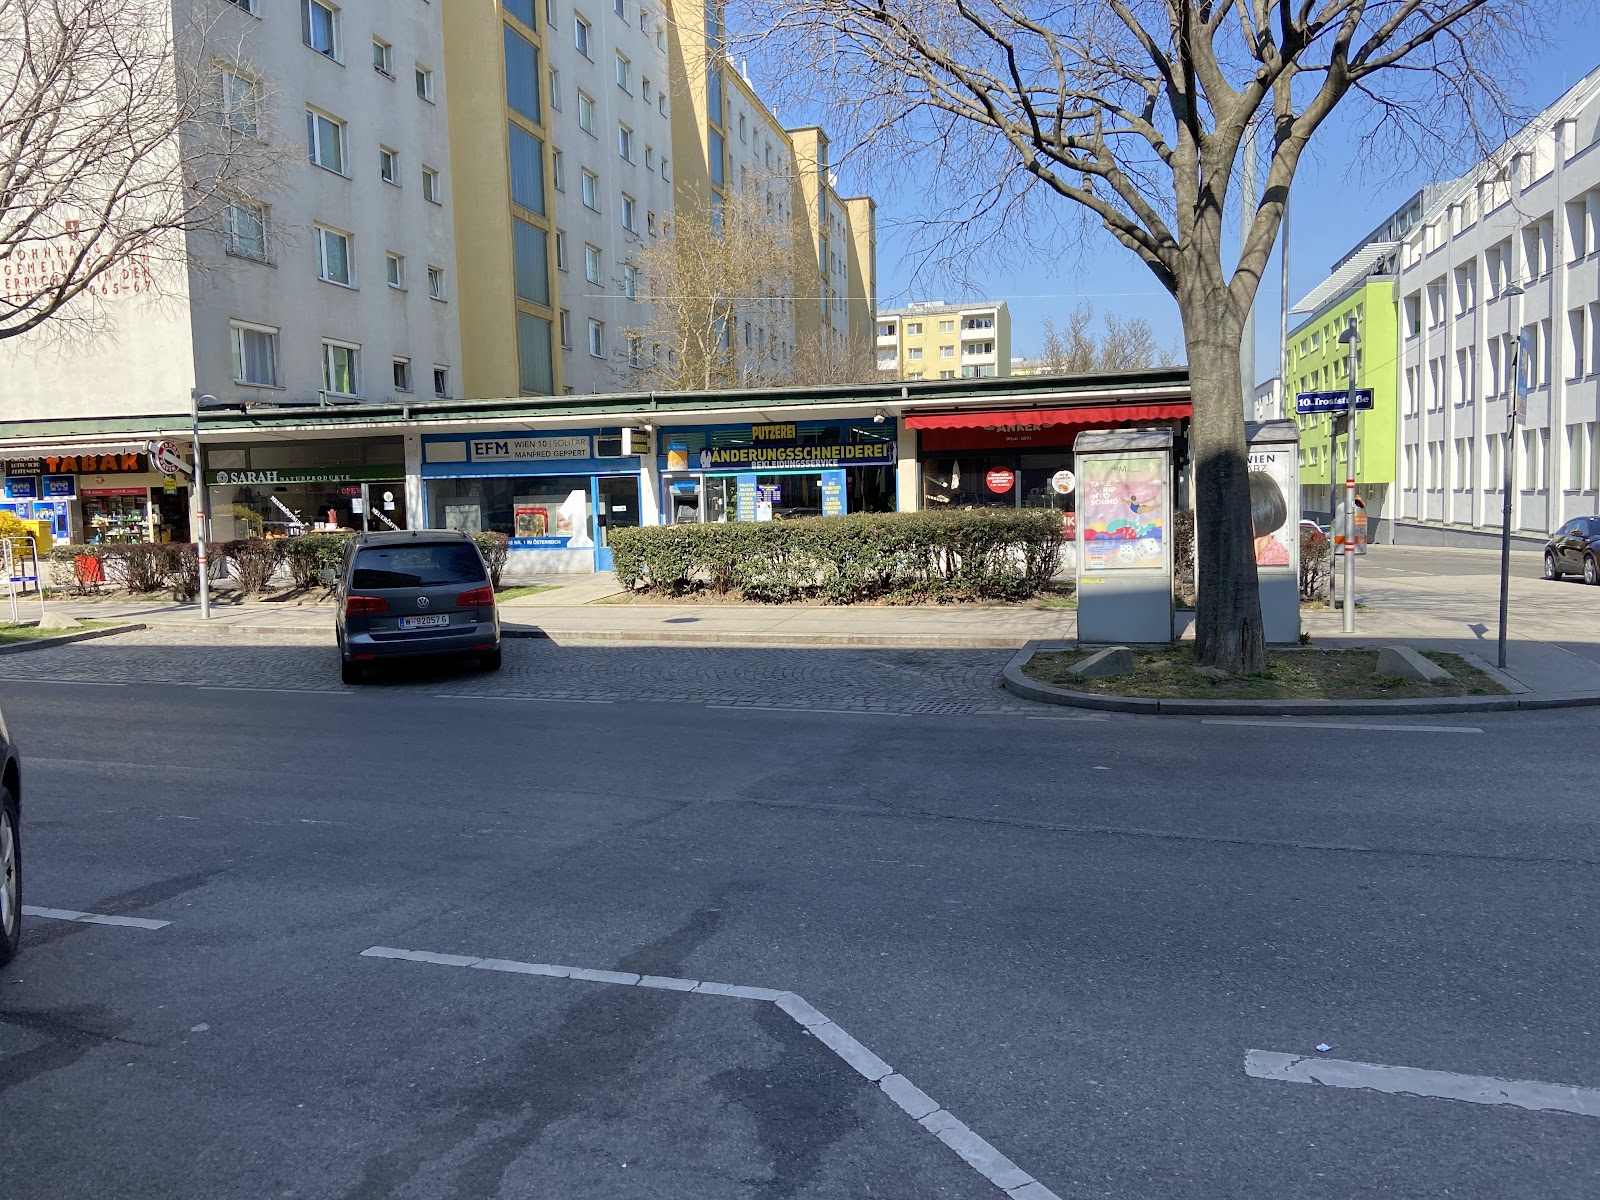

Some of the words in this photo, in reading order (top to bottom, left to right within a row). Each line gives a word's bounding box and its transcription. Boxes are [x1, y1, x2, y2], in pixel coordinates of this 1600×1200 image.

[4, 257, 92, 276] GEMEINE
[1314, 395, 1370, 406] Troststrße
[752, 424, 796, 440] PUTZEREI
[996, 424, 1041, 432] ANKER
[474, 442, 510, 455] EFM
[514, 440, 536, 448] WIEN
[553, 438, 586, 447] SOLITÄR
[711, 443, 888, 463] ÄNDERUNGSSCHNEIDEREI
[515, 450, 551, 458] MANFRED
[554, 449, 586, 457] GEPPERT
[46, 453, 138, 473] TABAK
[751, 459, 839, 469] BEKLEIDUNGSSERVICE
[231, 471, 278, 484] SARAH
[416, 616, 440, 624] 92057
